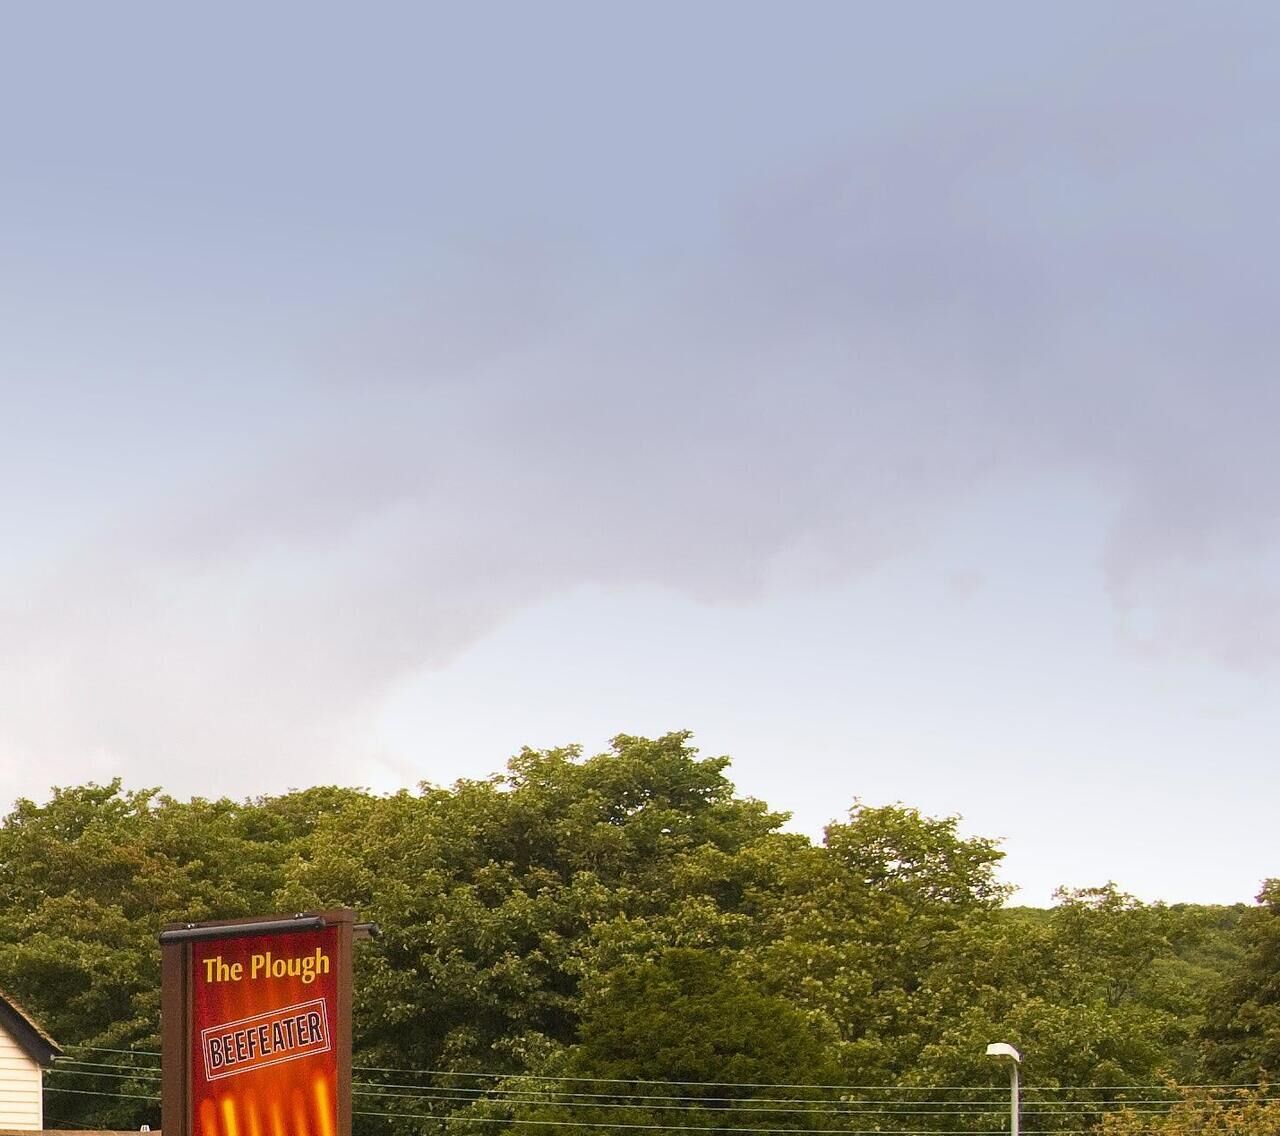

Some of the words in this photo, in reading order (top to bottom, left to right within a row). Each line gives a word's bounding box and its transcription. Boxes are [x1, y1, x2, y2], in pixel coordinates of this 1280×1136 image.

[202, 956, 243, 983] The
[251, 947, 330, 984] Plough
[208, 1012, 323, 1068] BEEFEATER
